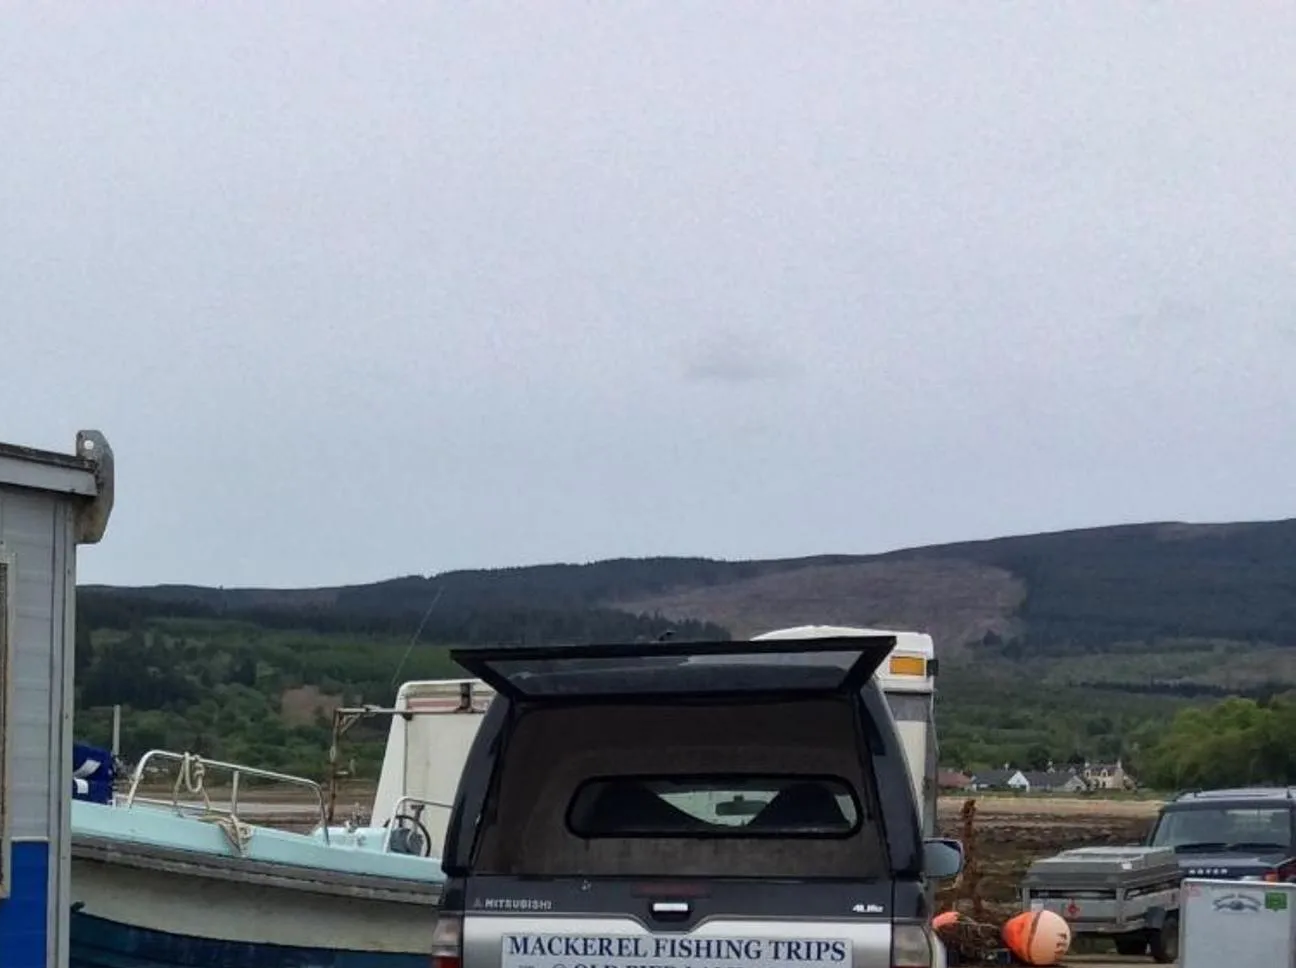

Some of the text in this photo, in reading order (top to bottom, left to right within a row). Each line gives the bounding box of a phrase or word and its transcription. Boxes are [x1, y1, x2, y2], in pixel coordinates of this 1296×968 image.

[484, 898, 552, 910] MITSUBISHI
[509, 936, 845, 961] MACKEREL FISHING TRIPS
